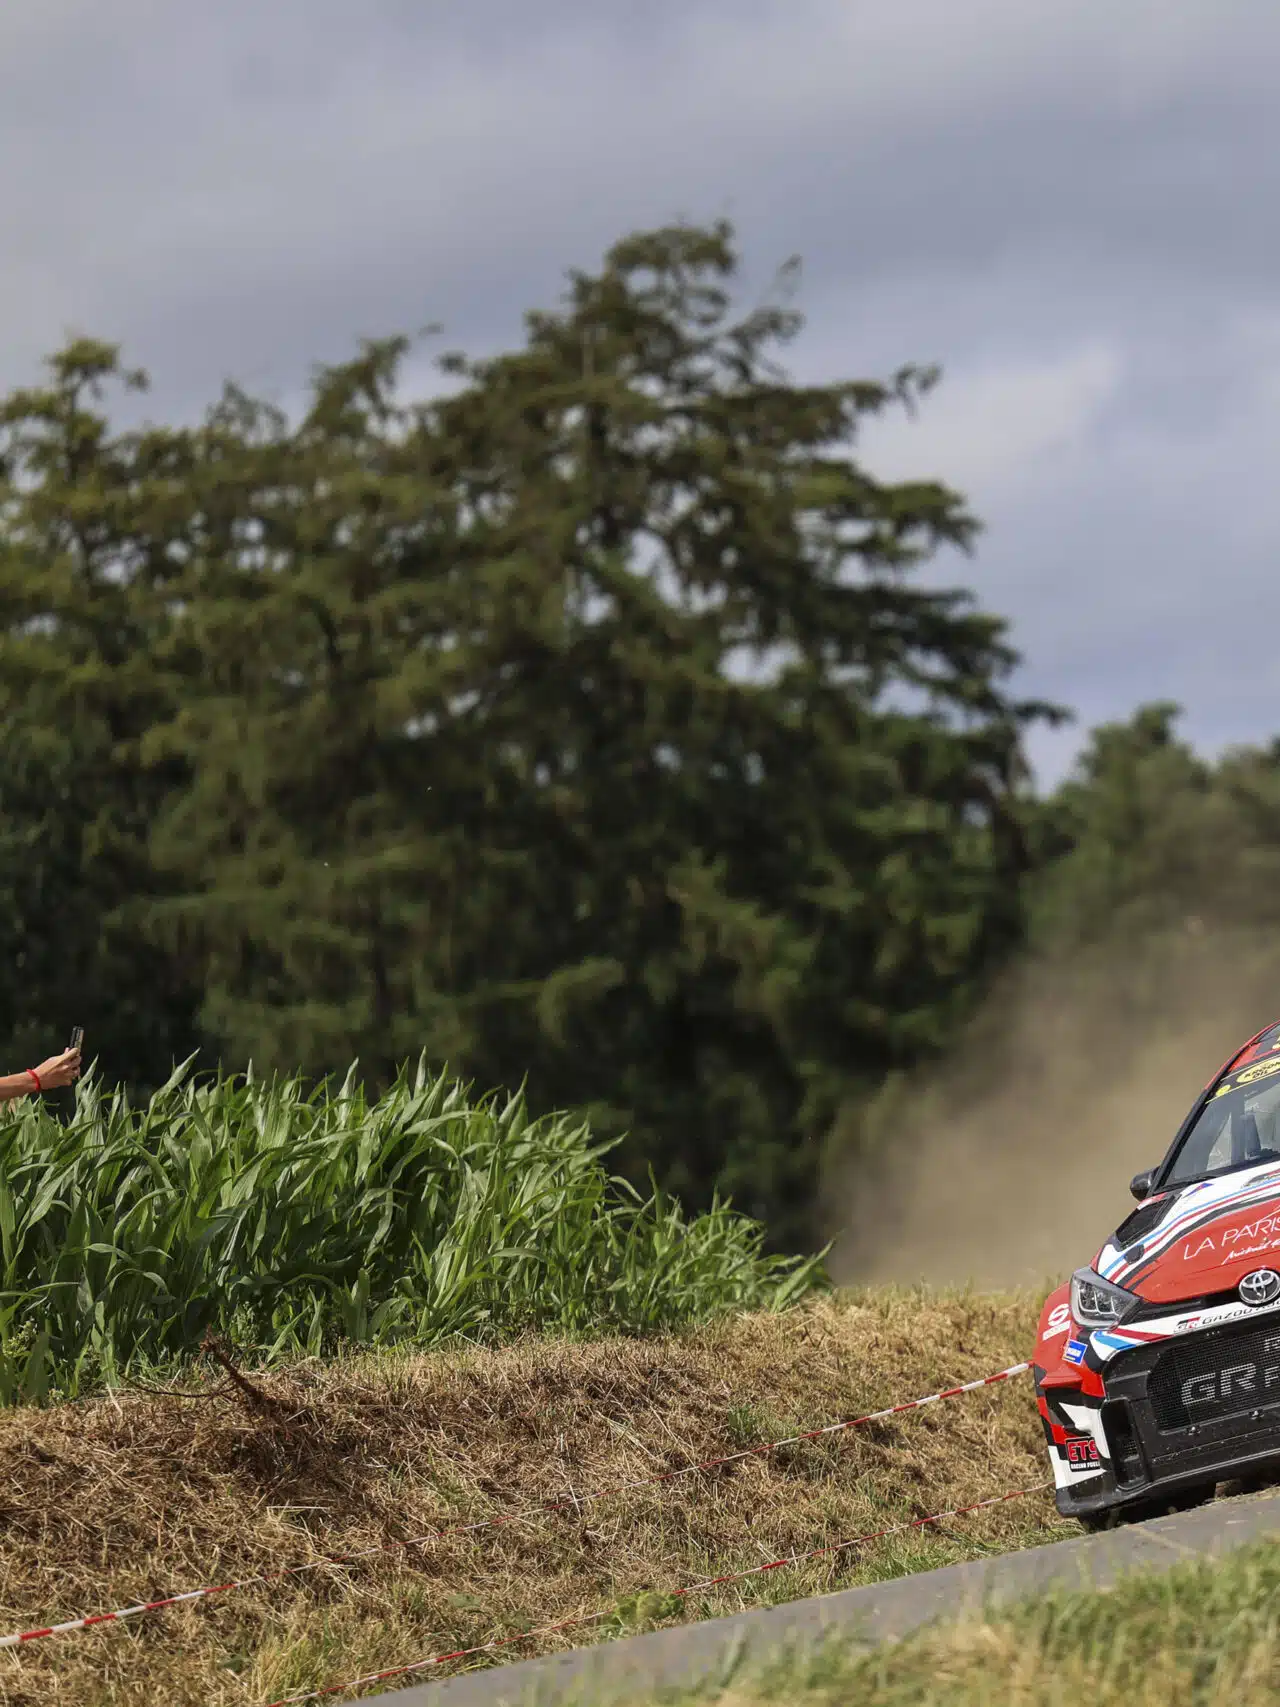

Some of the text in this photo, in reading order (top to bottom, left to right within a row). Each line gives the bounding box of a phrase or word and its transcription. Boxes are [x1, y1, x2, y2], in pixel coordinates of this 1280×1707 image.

[1184, 1235, 1216, 1261] LA
[1181, 1362, 1257, 1406] GR
[1067, 1440, 1100, 1462] ETS
